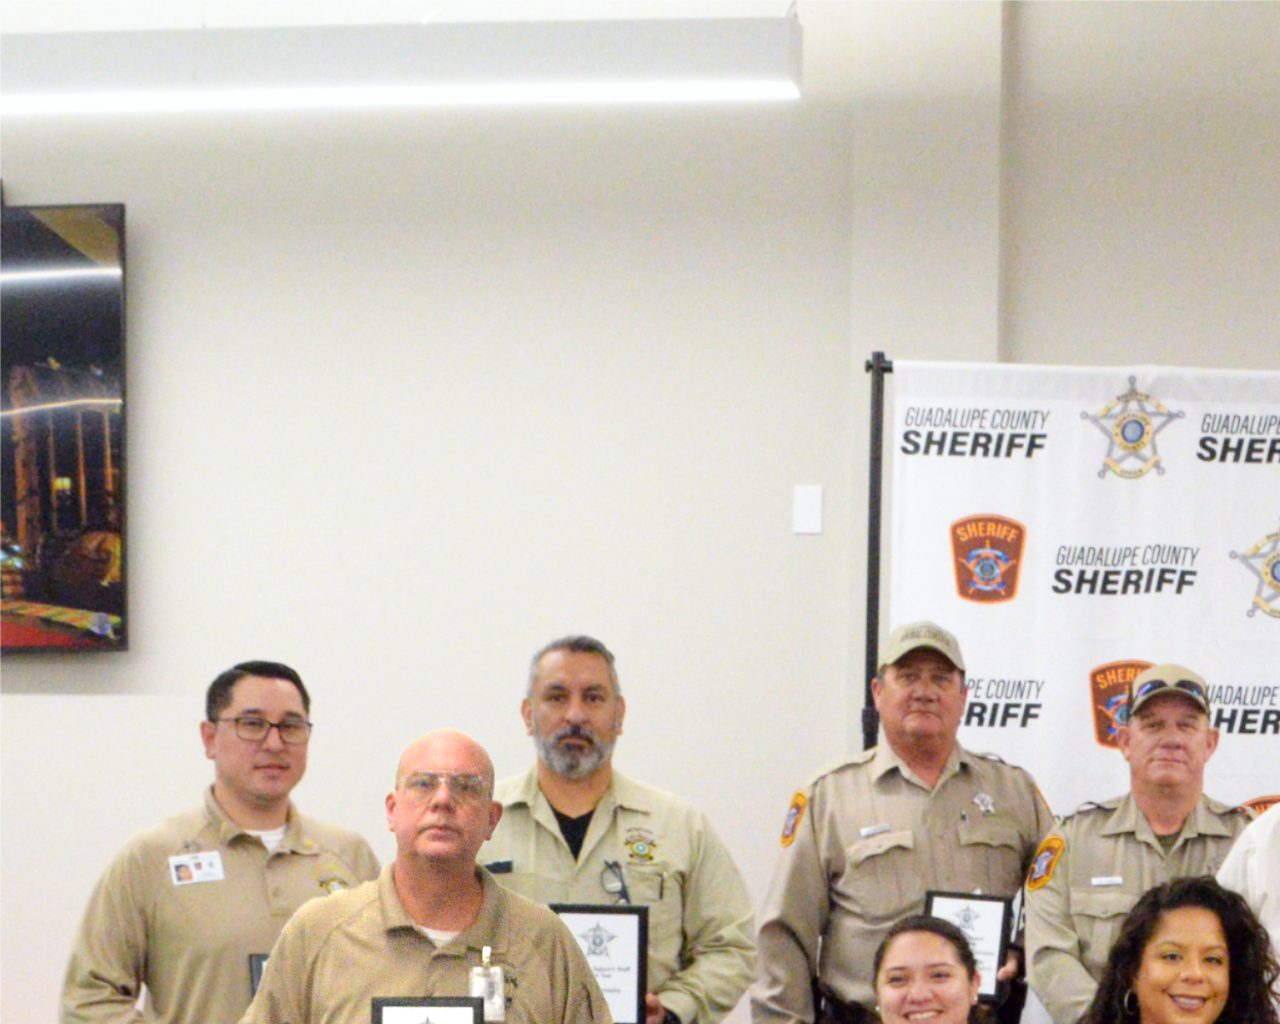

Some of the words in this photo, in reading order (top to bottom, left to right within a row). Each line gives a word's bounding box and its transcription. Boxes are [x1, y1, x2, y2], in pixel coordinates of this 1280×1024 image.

[904, 407, 988, 429] GUADALUPE
[990, 408, 1050, 430] COUNTY
[901, 431, 1047, 458] SHERIFF
[956, 521, 1020, 542] SHERIFF
[1055, 546, 1139, 566] GUADALUPE
[1141, 545, 1200, 566] COUNTY
[1052, 568, 1197, 595] SHERIFF
[1096, 667, 1137, 689] SHER
[986, 679, 1045, 700] COUNTY
[1208, 685, 1279, 705] UADALUPE
[964, 702, 1042, 727] RIFF
